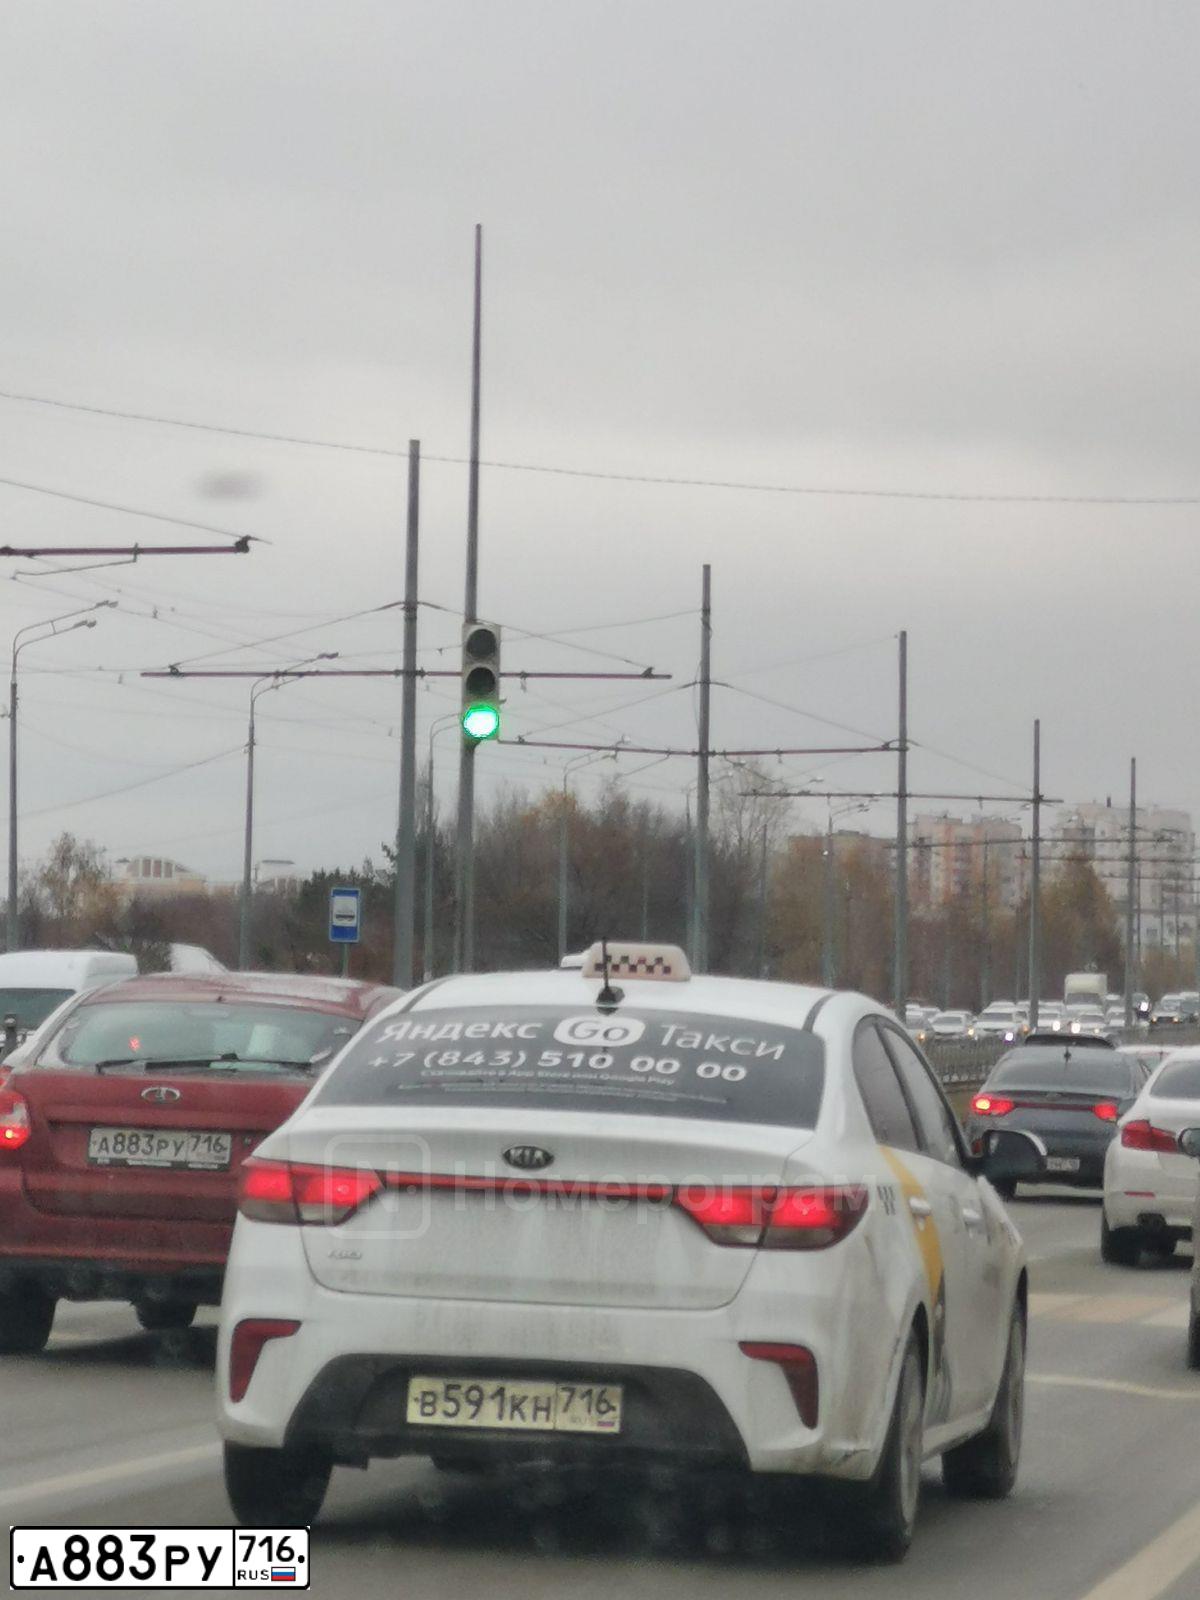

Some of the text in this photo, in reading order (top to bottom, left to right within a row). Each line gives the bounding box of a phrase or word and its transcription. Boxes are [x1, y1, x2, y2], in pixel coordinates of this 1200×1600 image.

[375, 1020, 786, 1061] Яндекс Go Такси
[368, 1050, 748, 1082] +7 (843) 510 00 00
[97, 1131, 224, 1157] А883РУ 716
[419, 1384, 612, 1423] В591КН 716
